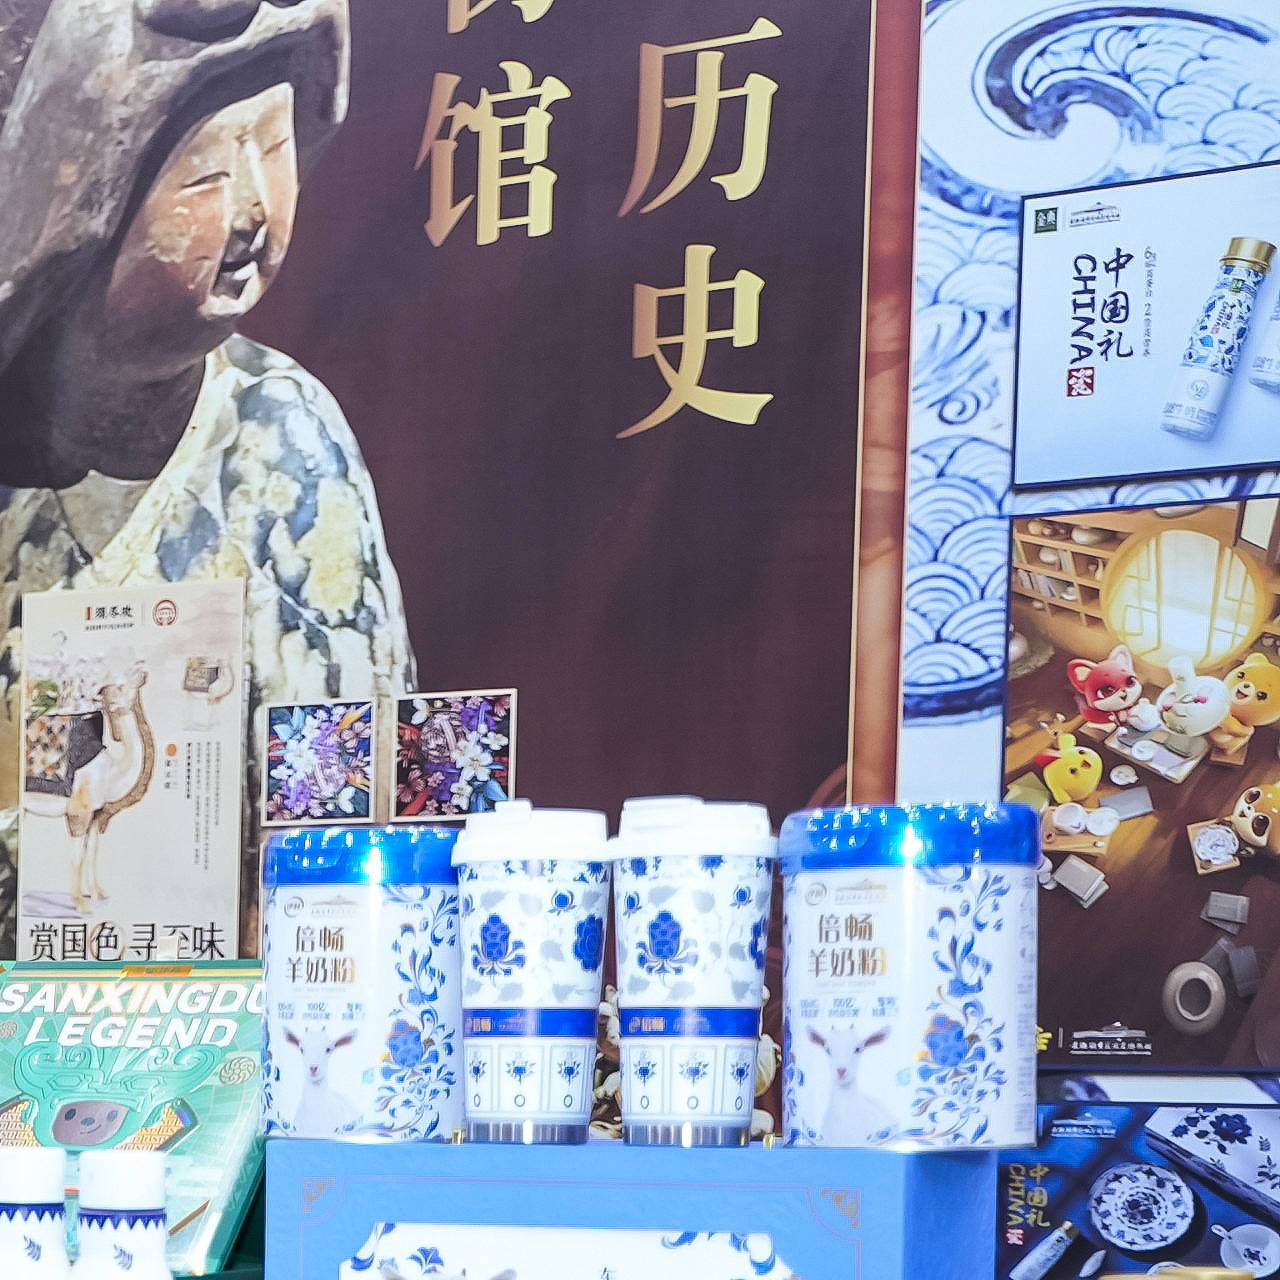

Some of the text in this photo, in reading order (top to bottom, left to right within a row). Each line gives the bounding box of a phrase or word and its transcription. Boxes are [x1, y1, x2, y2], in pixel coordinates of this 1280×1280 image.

[616, 17, 784, 439] 历史
[1070, 253, 1097, 365] CHINA
[1096, 247, 1134, 362] 中国礼
[296, 925, 345, 953] 倍畅
[819, 914, 873, 944] 倍畅
[285, 956, 356, 985] 羊奶粉
[807, 948, 888, 979] 羊奶粉
[25, 1016, 238, 1048] LEGEND
[1007, 1164, 1027, 1226] CHINA
